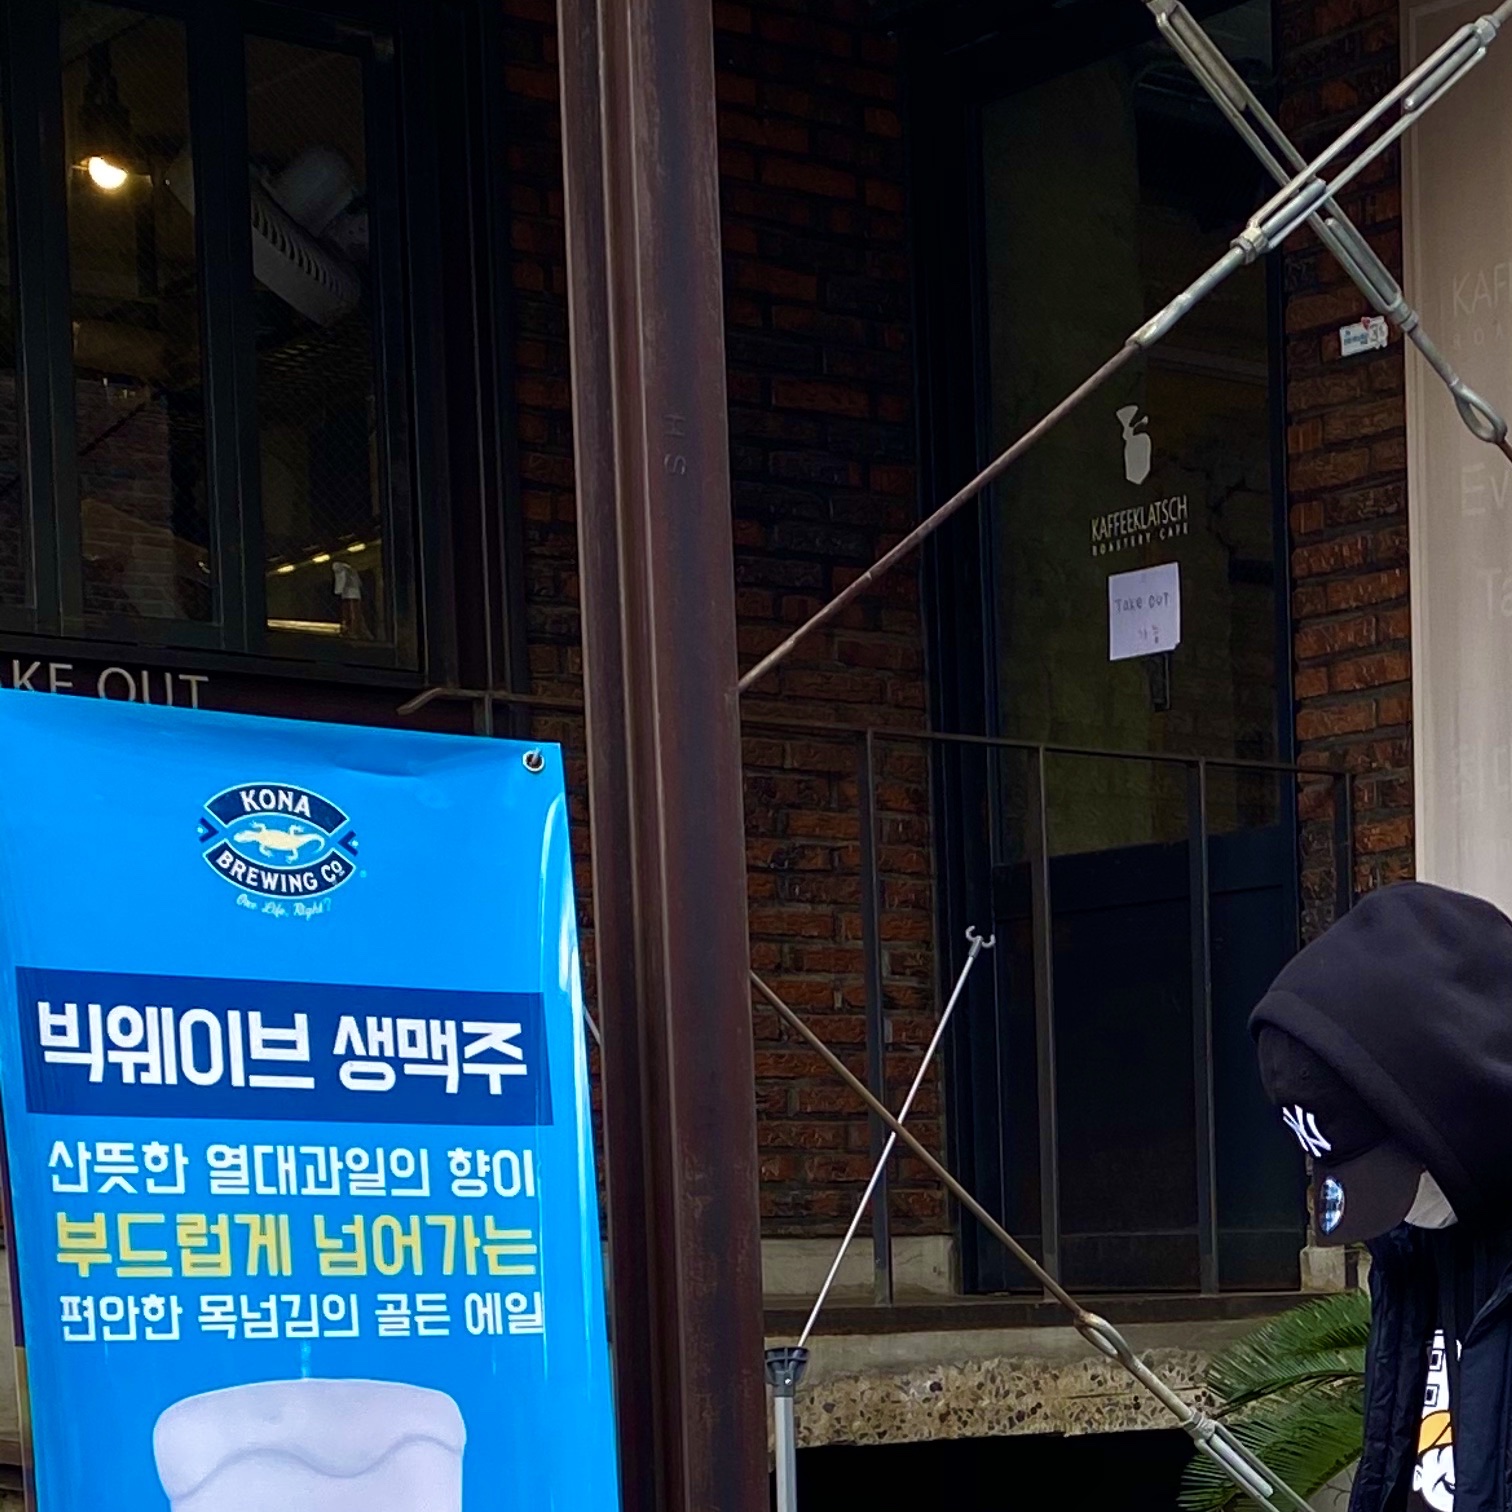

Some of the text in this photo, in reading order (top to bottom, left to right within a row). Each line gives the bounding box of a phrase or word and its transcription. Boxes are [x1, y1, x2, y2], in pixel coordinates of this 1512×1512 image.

[1090, 493, 1188, 542] KAFFEEKLATSCH
[2, 659, 210, 710] KE OUT
[239, 788, 312, 818] KONA
[216, 849, 319, 894] BREWING
[37, 1001, 528, 1095] 빅웨이브 생맥주
[48, 1140, 535, 1198] 산뜻한 열대과일의 향이
[56, 1212, 537, 1278] 부드럽게 넘어가는
[60, 1292, 546, 1342] 편안한 목넘김의 골든 에일
